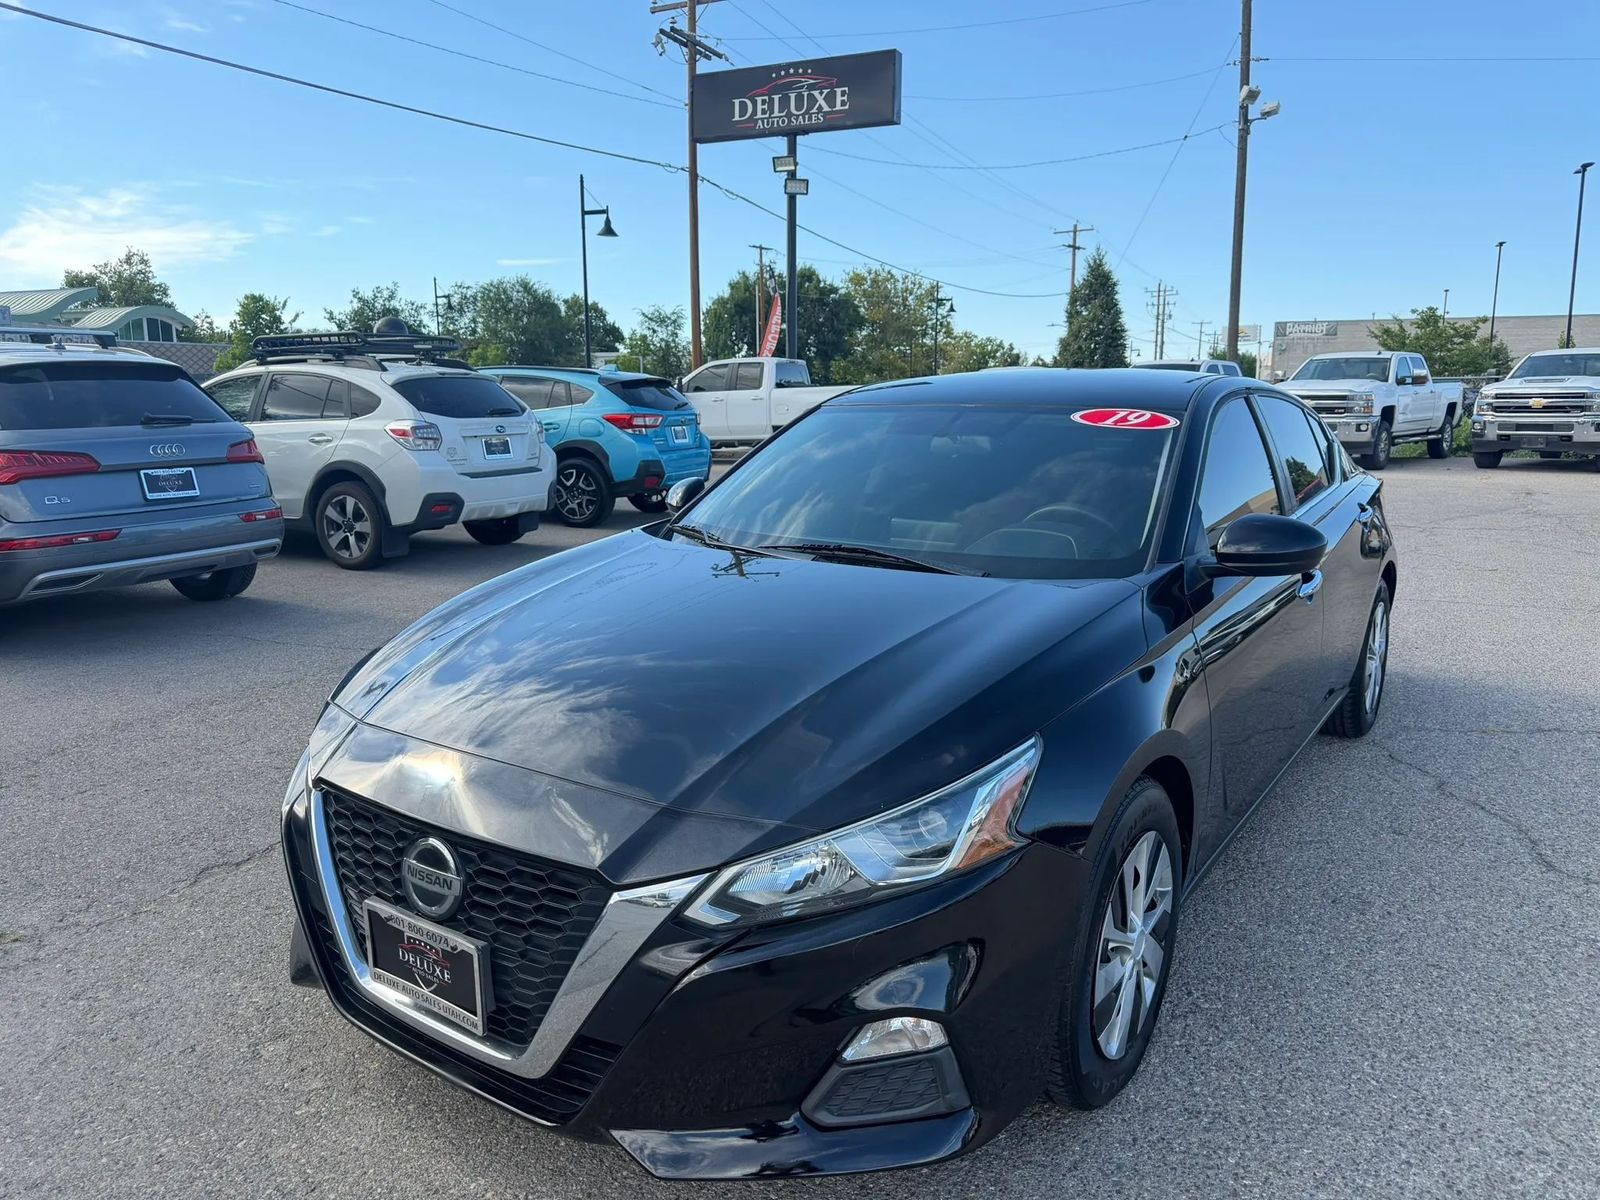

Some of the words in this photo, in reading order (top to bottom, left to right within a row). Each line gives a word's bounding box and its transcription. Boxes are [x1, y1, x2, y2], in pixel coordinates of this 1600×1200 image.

[731, 86, 850, 122] DELUXE
[756, 118, 789, 130] AUTO
[791, 113, 824, 125] SALES
[1097, 410, 1152, 426] 19
[45, 495, 71, 505] Q5
[407, 864, 453, 891] NISSAN
[399, 947, 452, 983] DELUXE
[373, 971, 400, 990] DELUXE
[402, 984, 420, 1000] AUTO
